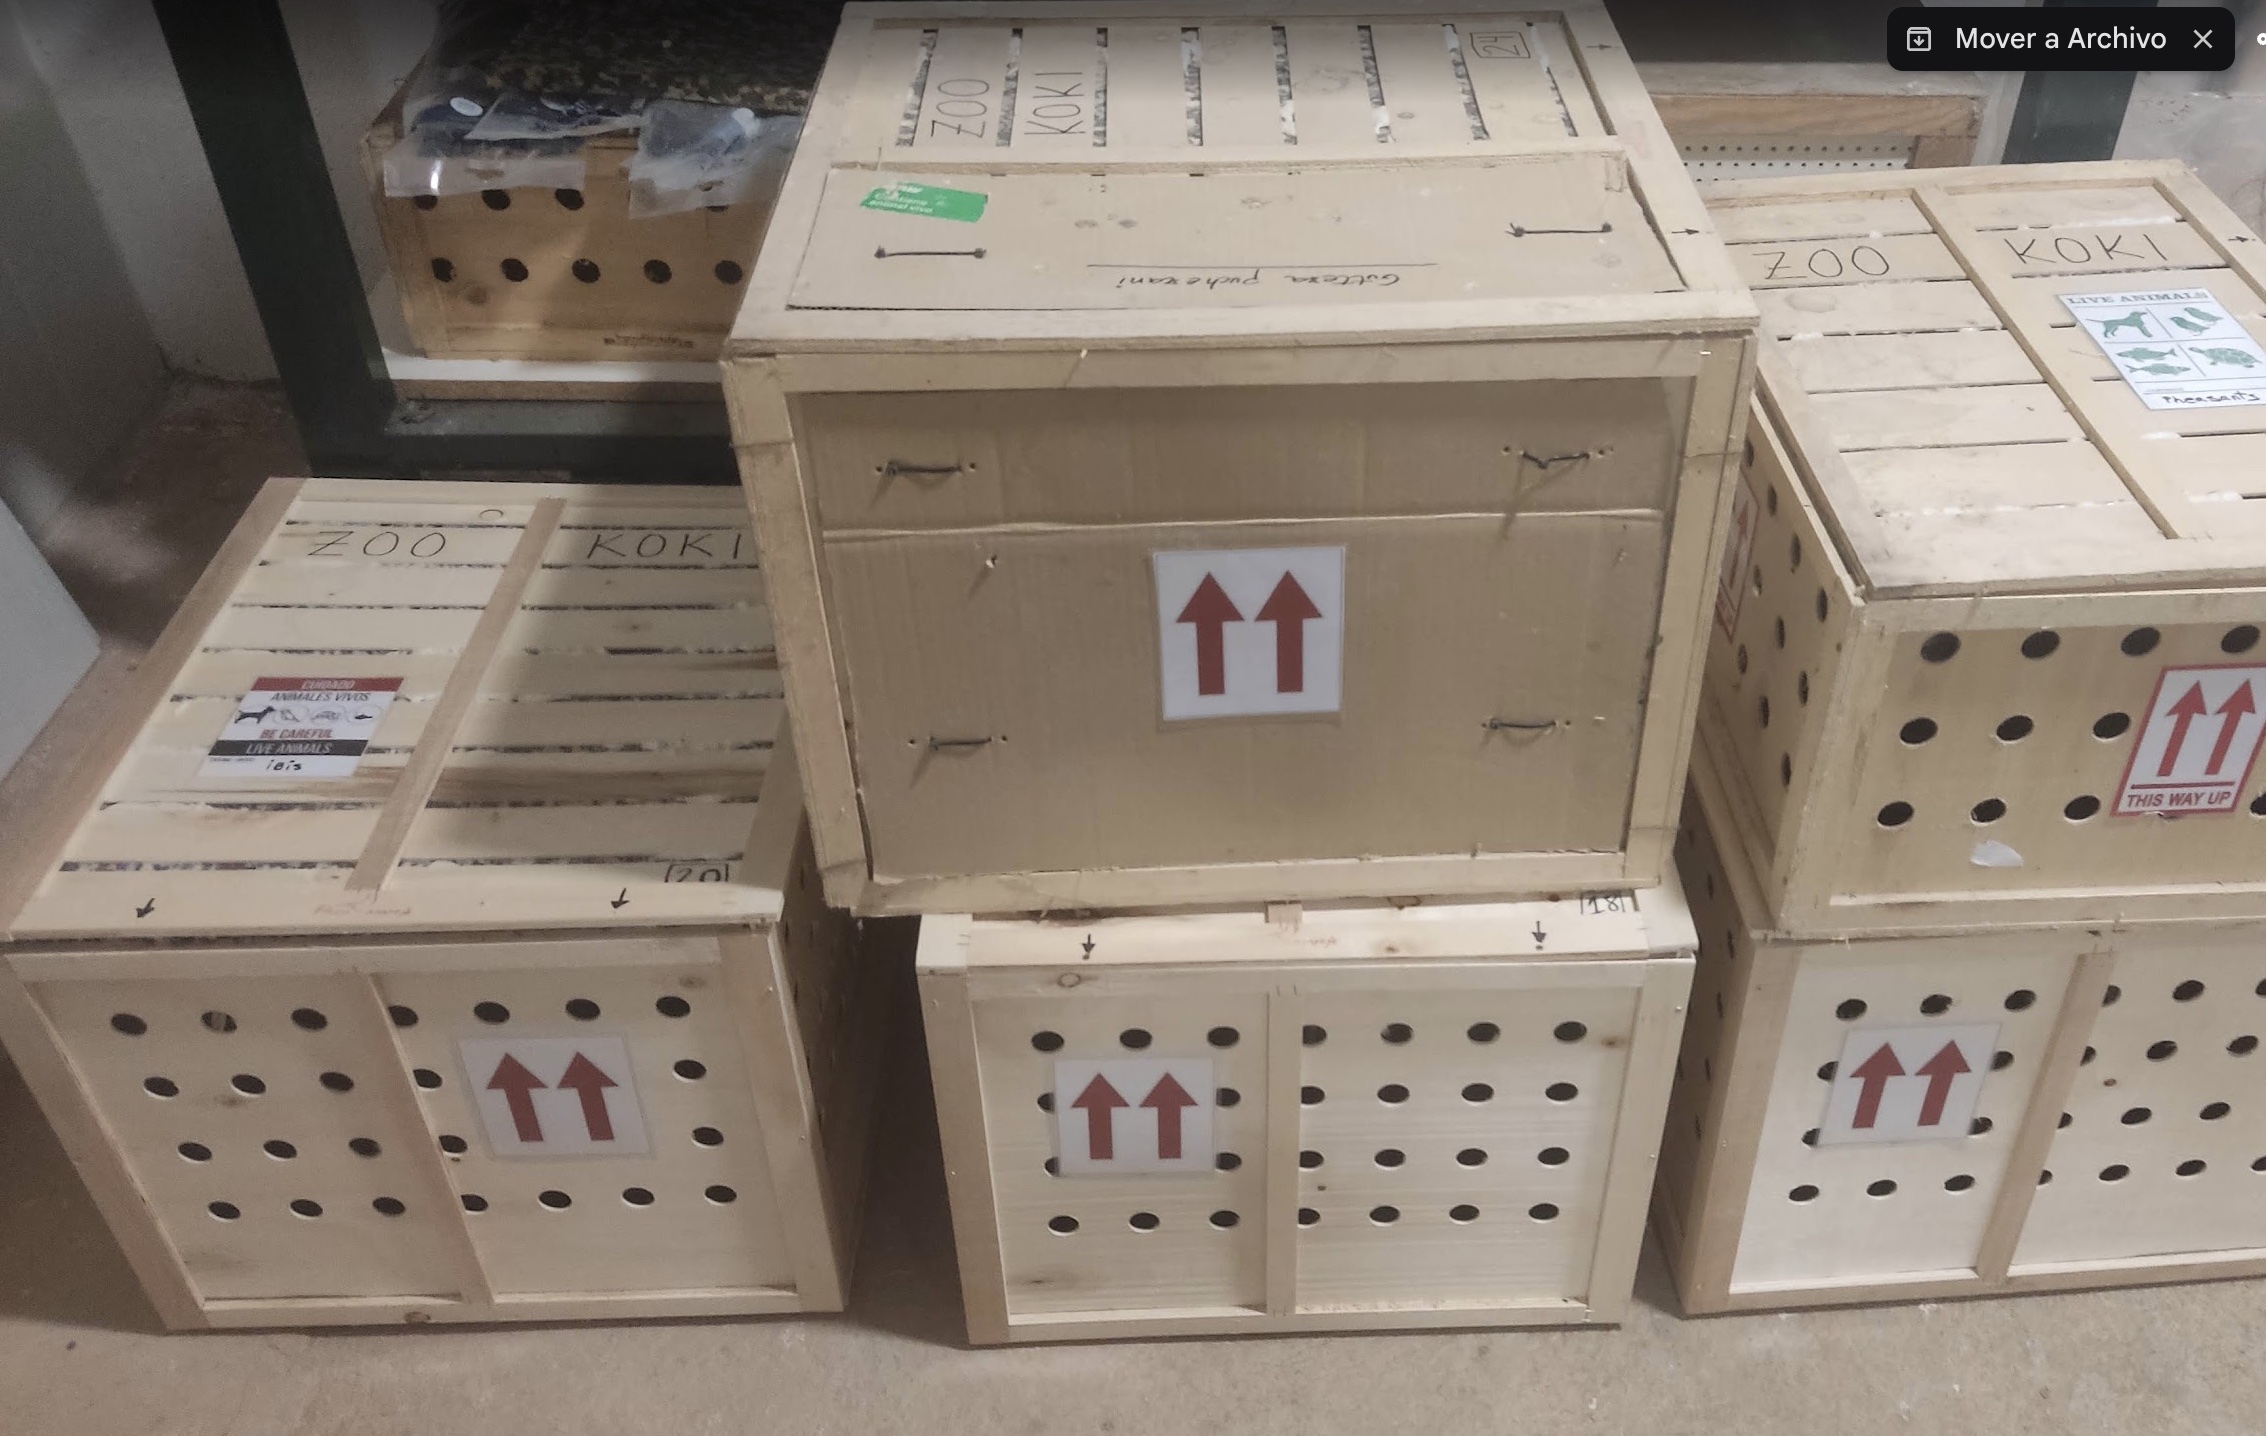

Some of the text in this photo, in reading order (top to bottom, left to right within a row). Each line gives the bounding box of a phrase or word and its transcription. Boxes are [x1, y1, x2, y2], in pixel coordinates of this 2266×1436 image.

[1476, 35, 1520, 56] 24
[930, 78, 990, 138] ZOO
[1023, 71, 1087, 135] KOKI
[2003, 233, 2168, 265] KOKI
[1751, 245, 1890, 280] ZOO
[2067, 291, 2209, 305] LIVE ANIMALS
[307, 530, 742, 560] ZOO KOKI
[301, 680, 356, 690] CUIDADO
[270, 692, 371, 702] ANIMALES VIVOS
[259, 729, 334, 739] BE CAREFUL
[245, 742, 333, 754] LIVE ANIMALS
[2127, 790, 2232, 808] THIS WAY UP
